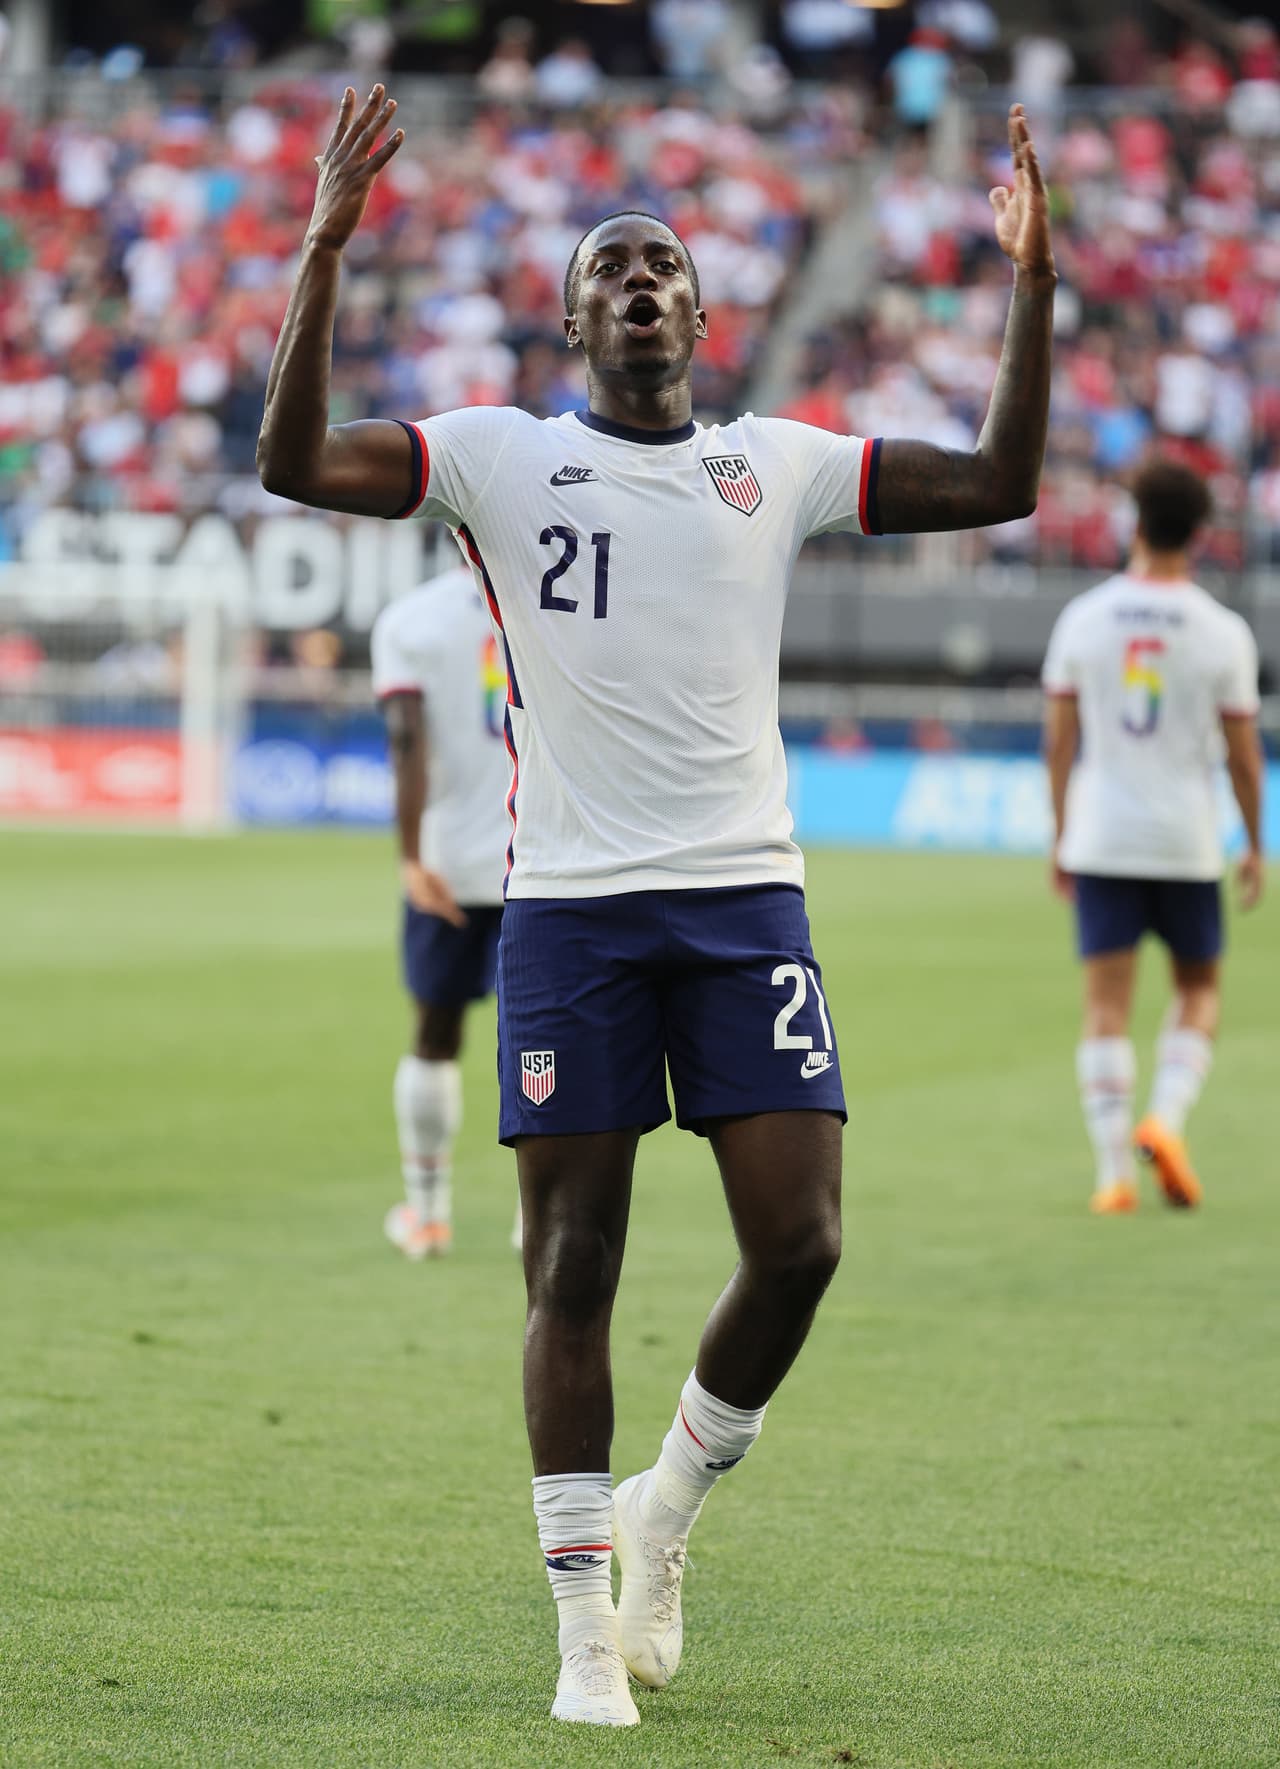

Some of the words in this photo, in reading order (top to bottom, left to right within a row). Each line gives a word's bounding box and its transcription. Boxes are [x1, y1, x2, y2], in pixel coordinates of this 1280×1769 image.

[558, 465, 593, 481] NIKE
[709, 459, 747, 480] USA
[539, 525, 611, 619] 21
[1122, 634, 1168, 738] 5
[771, 963, 833, 1051] 21
[523, 1054, 553, 1074] USA
[806, 1051, 830, 1067] NIKE
